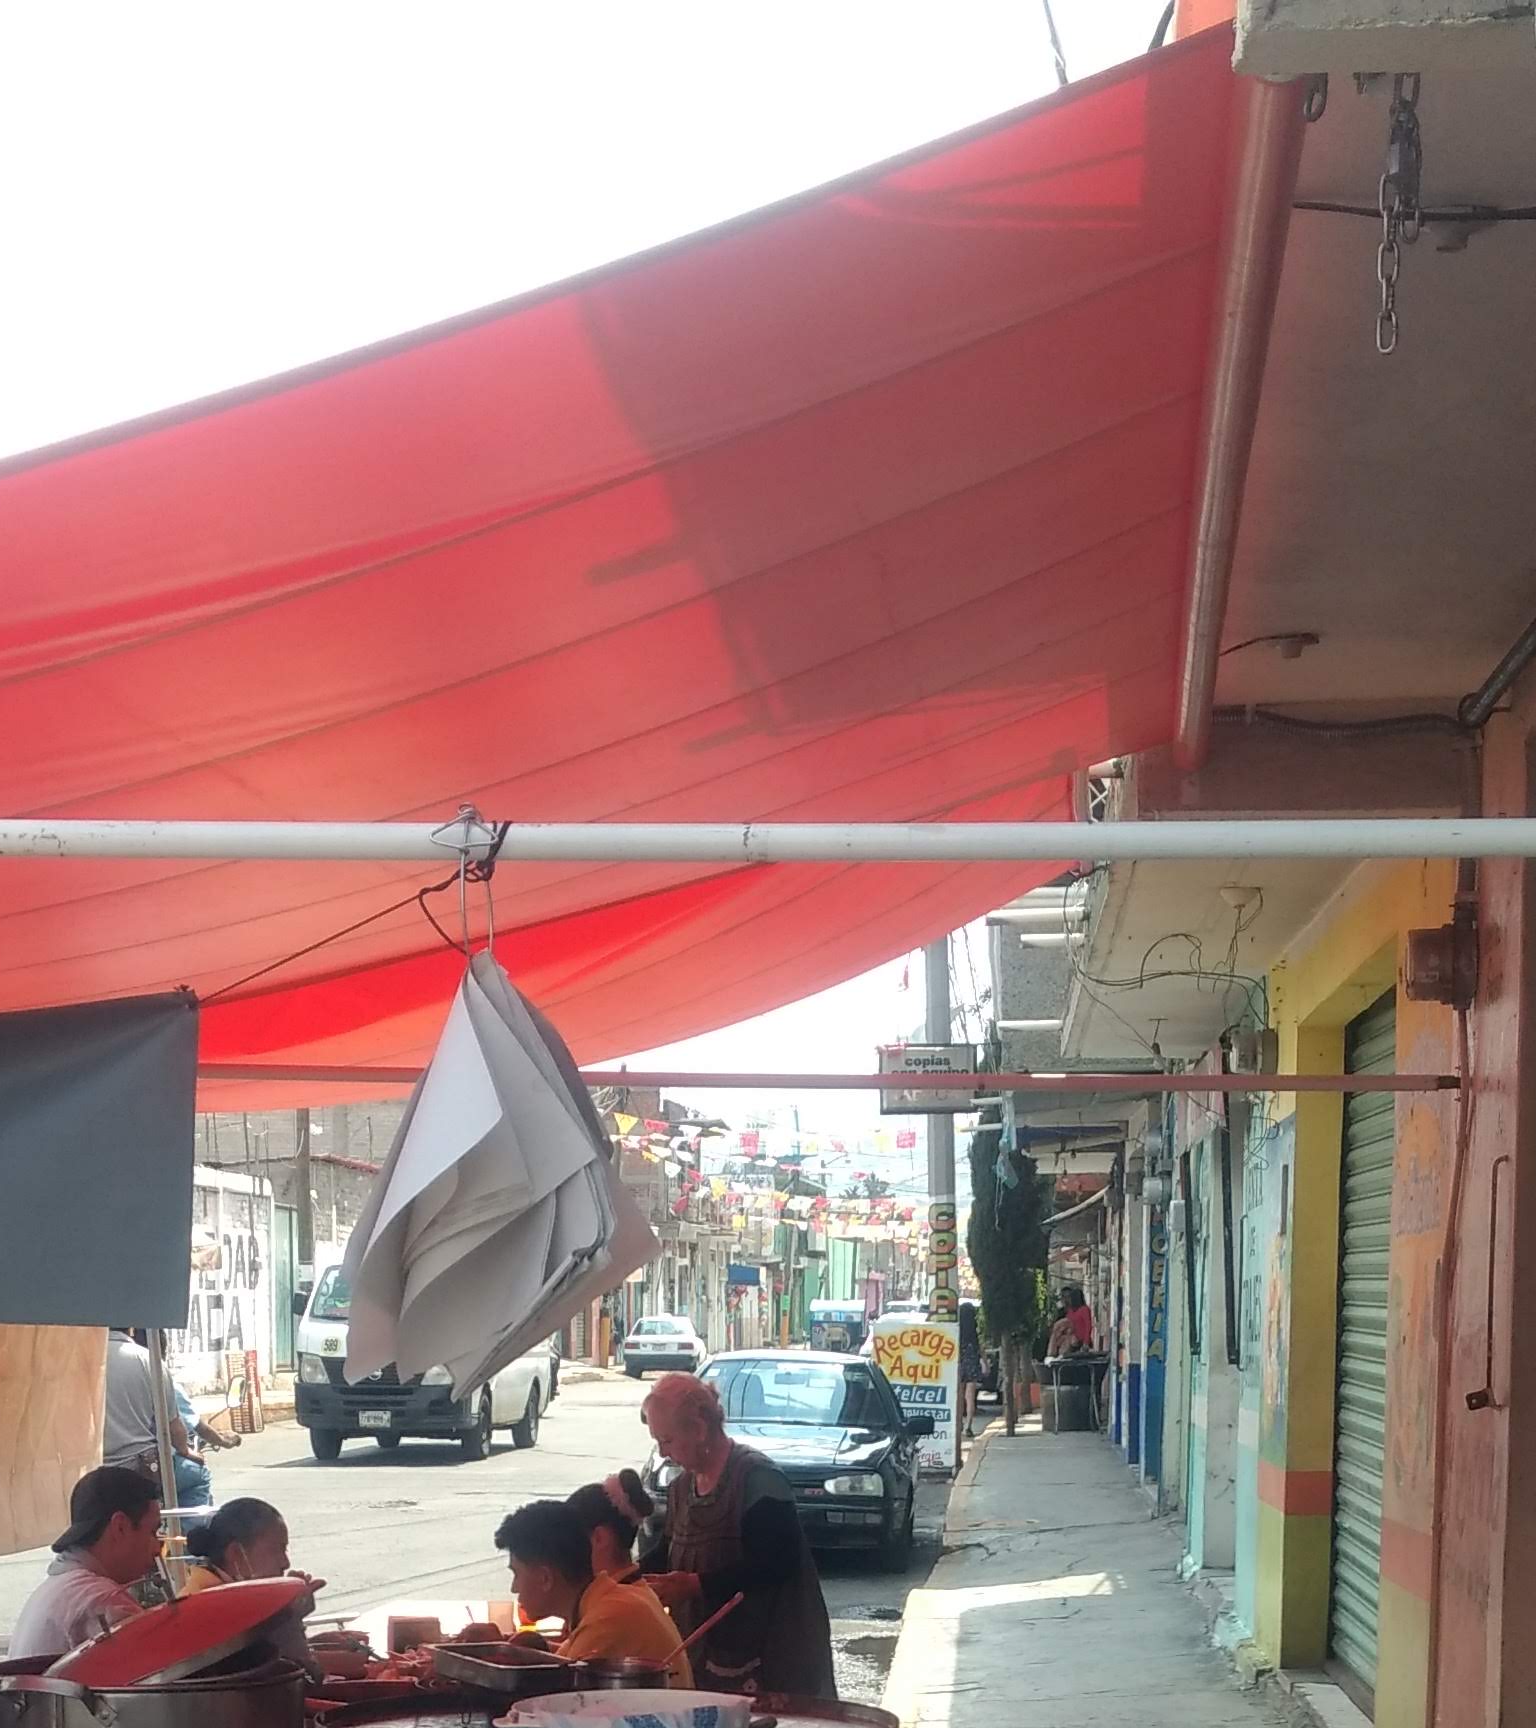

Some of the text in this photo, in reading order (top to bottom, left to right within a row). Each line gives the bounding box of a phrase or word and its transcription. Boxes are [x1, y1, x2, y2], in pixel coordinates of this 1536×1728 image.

[904, 1054, 951, 1069] copias
[872, 1328, 956, 1366] Recarga
[890, 1354, 941, 1383] Aqui
[893, 1385, 943, 1403] telcel
